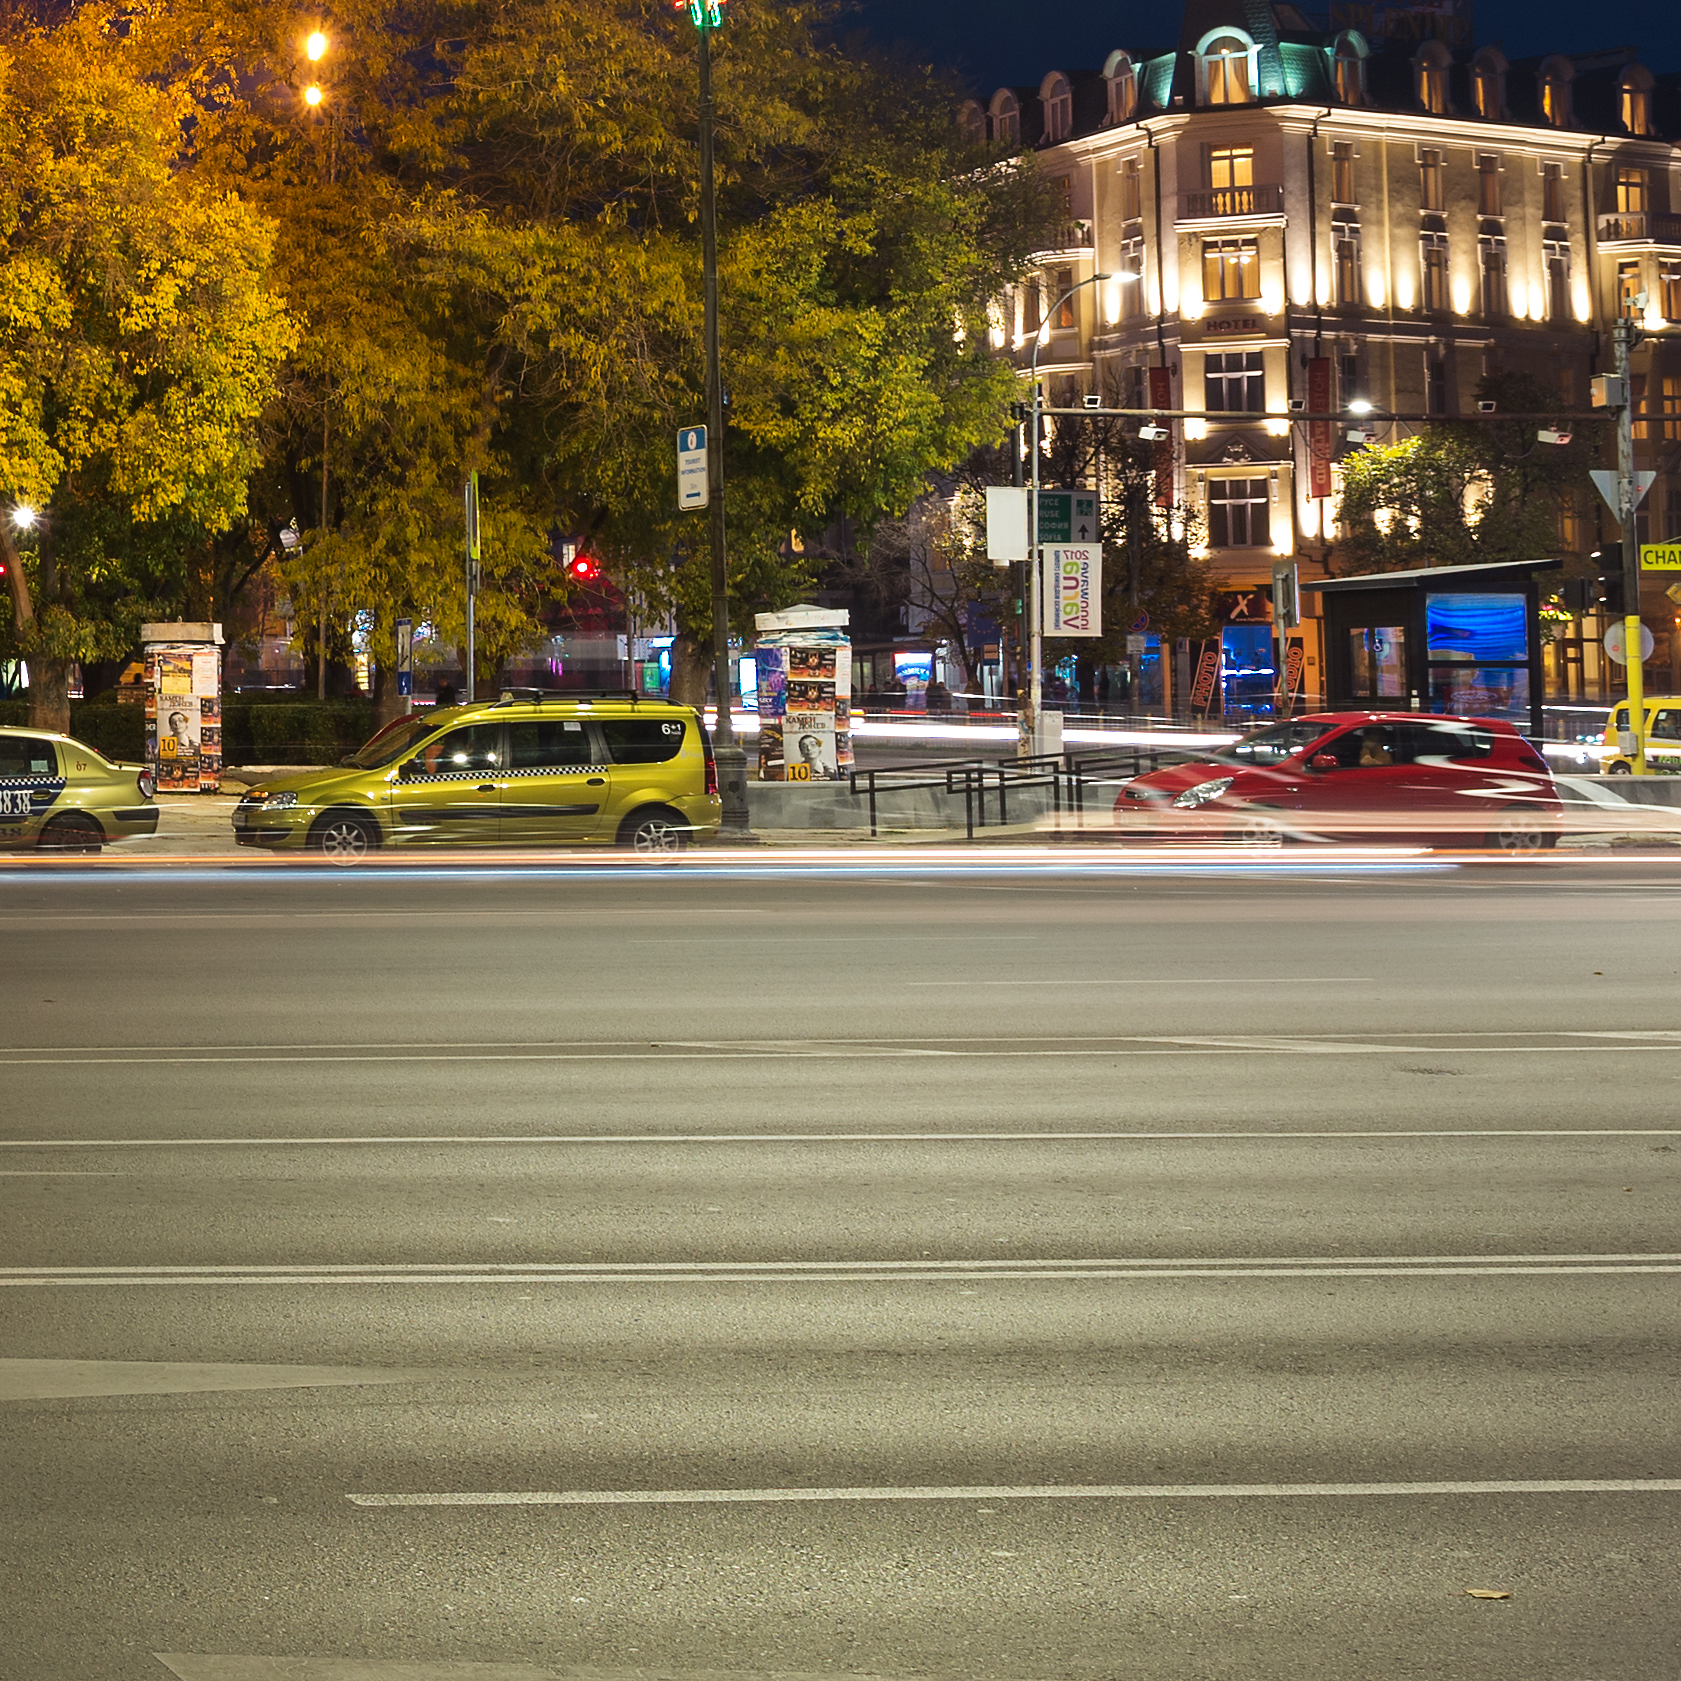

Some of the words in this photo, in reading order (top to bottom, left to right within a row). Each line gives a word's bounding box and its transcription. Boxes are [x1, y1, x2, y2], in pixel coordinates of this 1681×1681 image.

[1207, 319, 1258, 331] HOTEL
[685, 457, 701, 465] TOURIST
[681, 467, 706, 475] INFORMATION
[1039, 498, 1059, 506] РУСЕ
[1644, 550, 1681, 564] CHA
[1194, 651, 1217, 706] PHOTO
[662, 724, 681, 735] 6+1
[161, 739, 175, 751] 10
[76, 762, 87, 771] 07
[789, 766, 808, 780] 10
